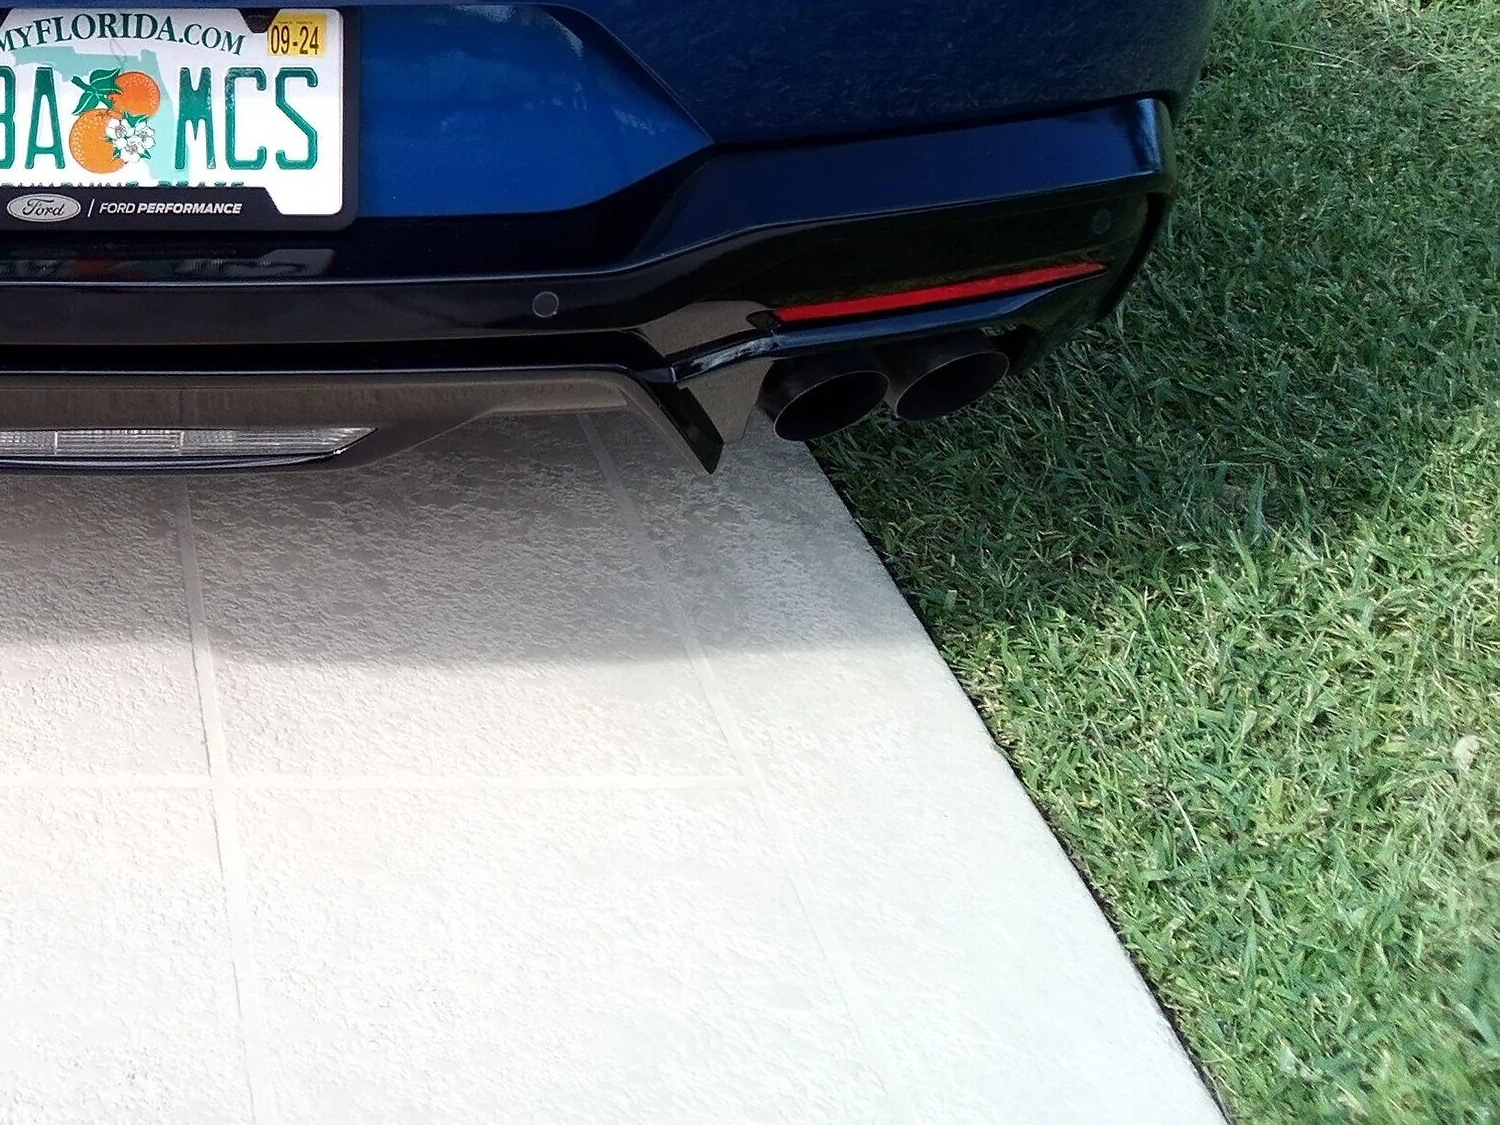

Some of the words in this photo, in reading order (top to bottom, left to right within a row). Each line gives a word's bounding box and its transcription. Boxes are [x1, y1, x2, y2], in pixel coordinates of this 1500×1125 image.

[270, 25, 319, 55] 09-24
[174, 66, 318, 170] MCS
[22, 198, 65, 217] Ford
[99, 202, 135, 214] FORD
[137, 202, 242, 215] PERFORMANCE
